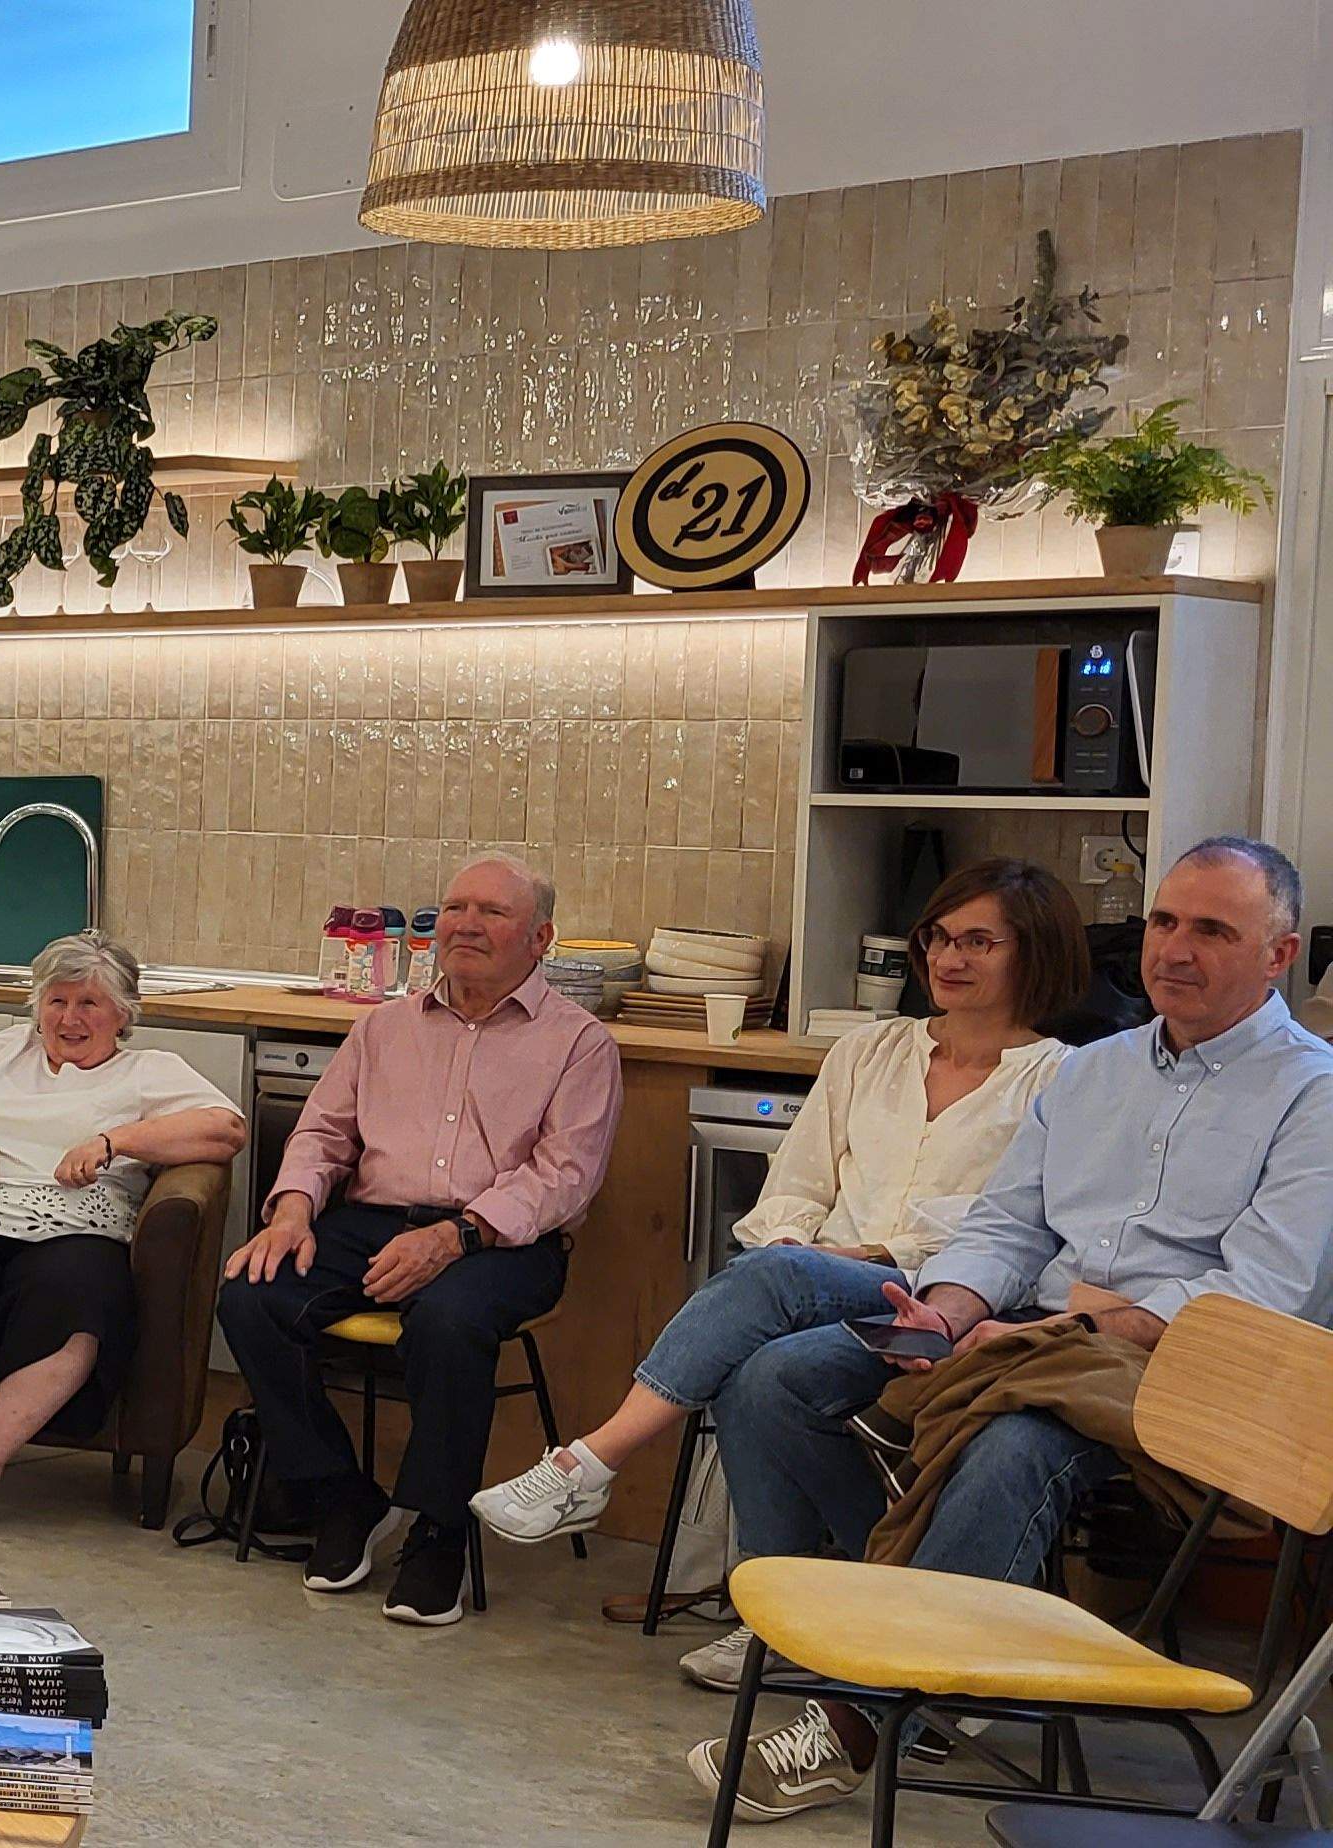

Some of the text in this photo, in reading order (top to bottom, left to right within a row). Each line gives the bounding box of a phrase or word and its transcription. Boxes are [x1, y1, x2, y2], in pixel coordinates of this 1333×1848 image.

[28, 1655, 63, 1663] JUAN
[26, 1669, 62, 1677] JUAN
[28, 1679, 64, 1687] JUAN
